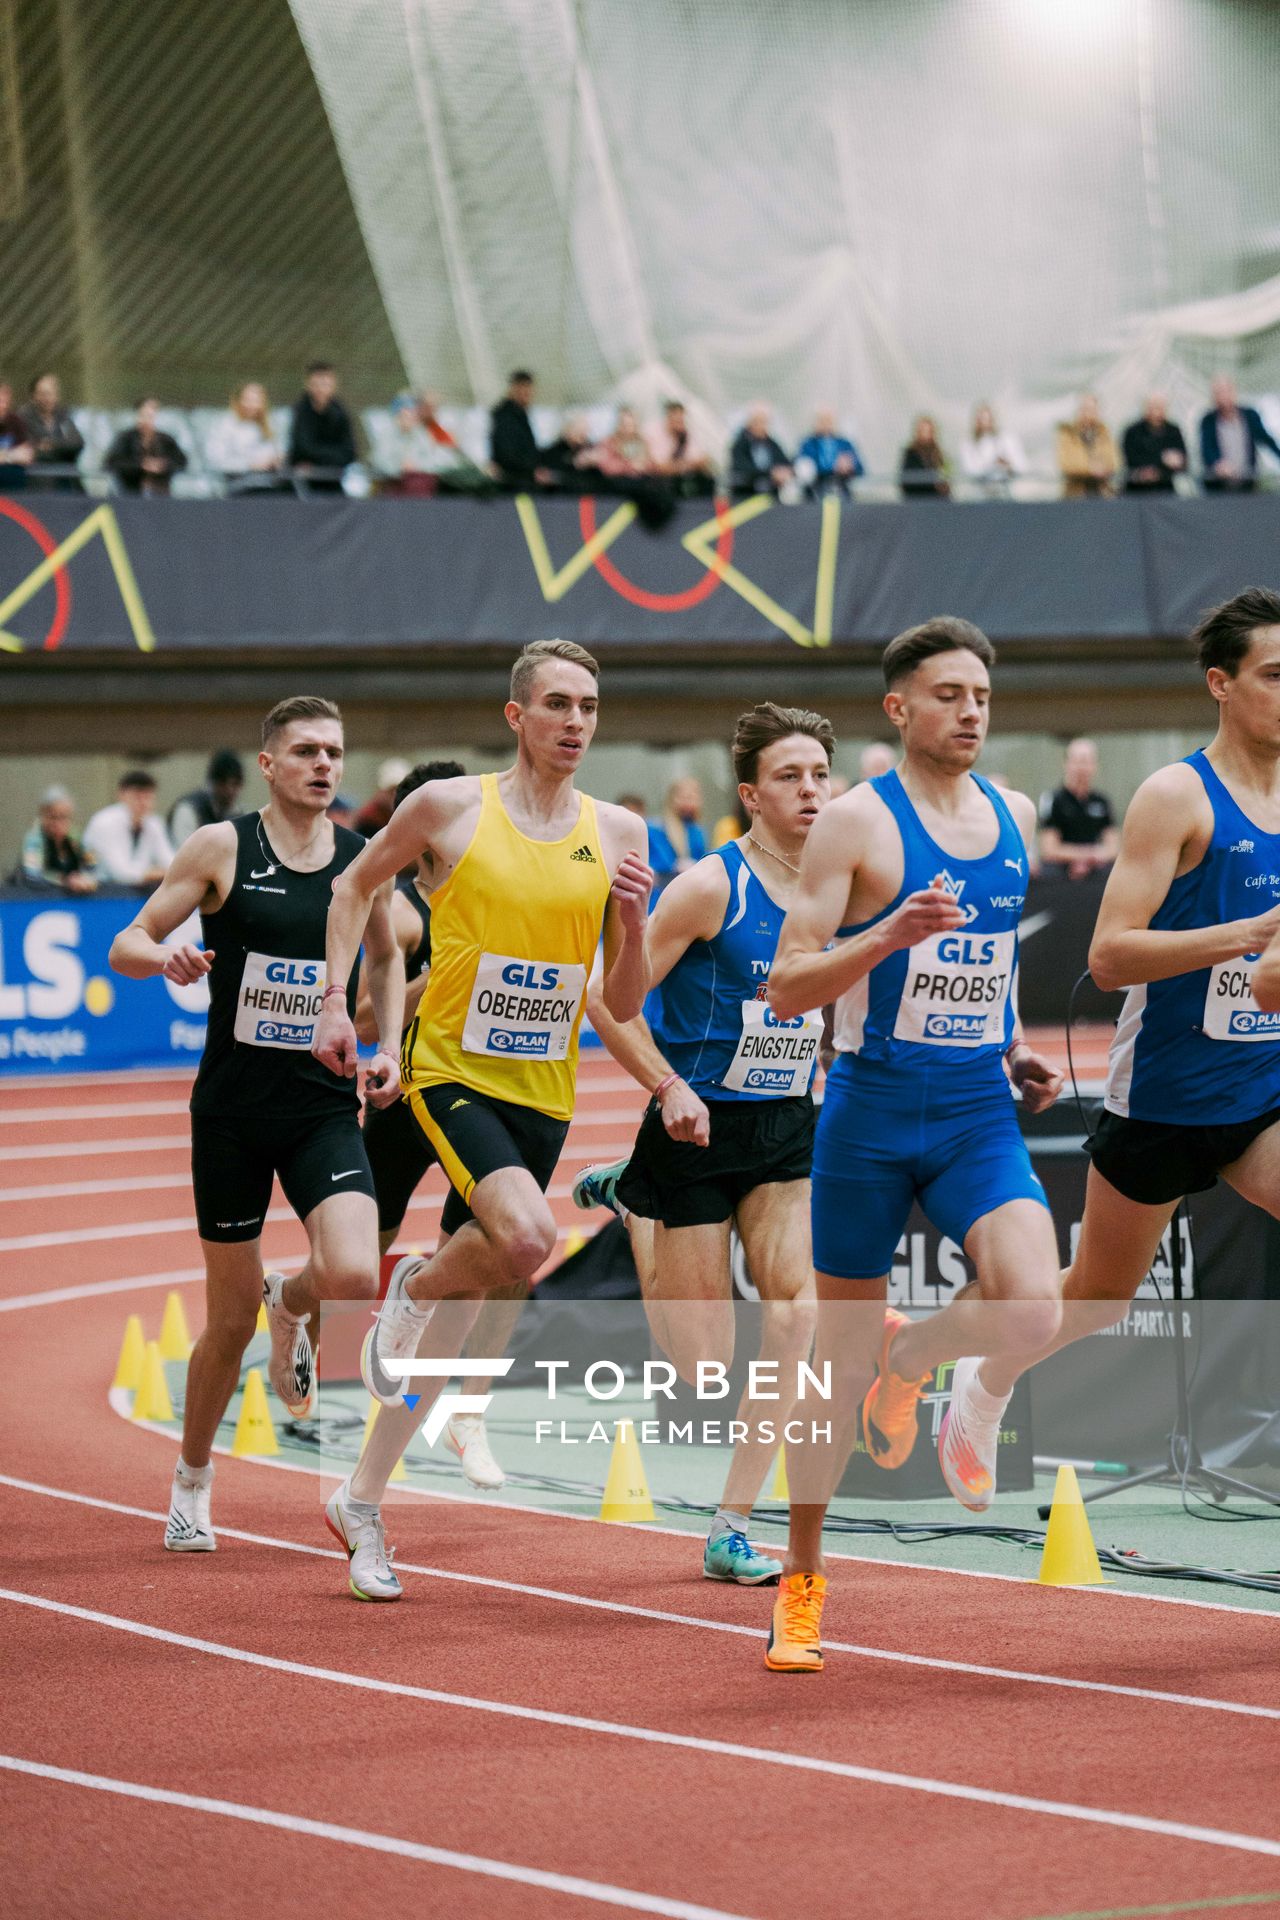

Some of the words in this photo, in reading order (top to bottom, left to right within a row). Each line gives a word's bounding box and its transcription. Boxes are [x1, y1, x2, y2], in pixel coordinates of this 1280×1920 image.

[570, 854, 597, 864] adidas
[1244, 873, 1268, 890] Café
[911, 973, 1007, 1003] PROBST
[477, 990, 576, 1023] OBERBECK
[280, 1026, 311, 1038] PLAN
[514, 1035, 547, 1047] PLAN
[740, 1036, 817, 1061] ENGSTLER
[765, 1072, 793, 1083] PLAN
